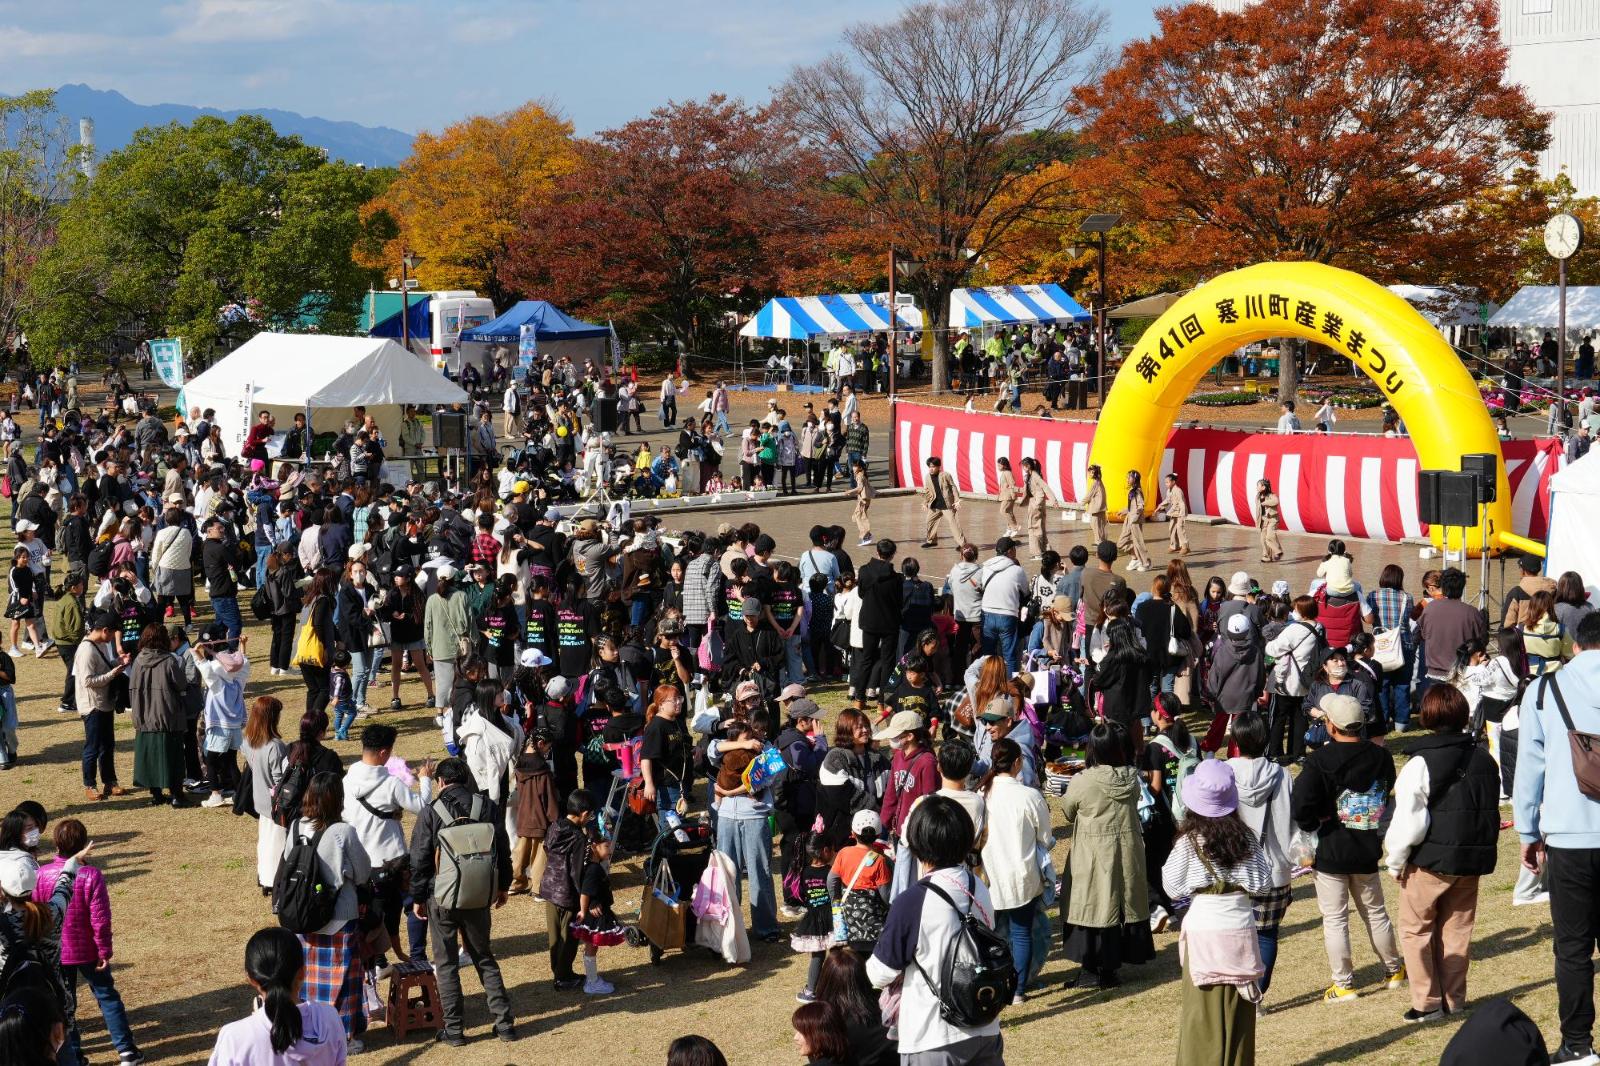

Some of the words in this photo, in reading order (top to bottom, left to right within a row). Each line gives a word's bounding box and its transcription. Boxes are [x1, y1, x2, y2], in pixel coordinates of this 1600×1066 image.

[1136, 312, 1205, 384] 第41回
[1215, 293, 1404, 394] 寒川町産業まつり
